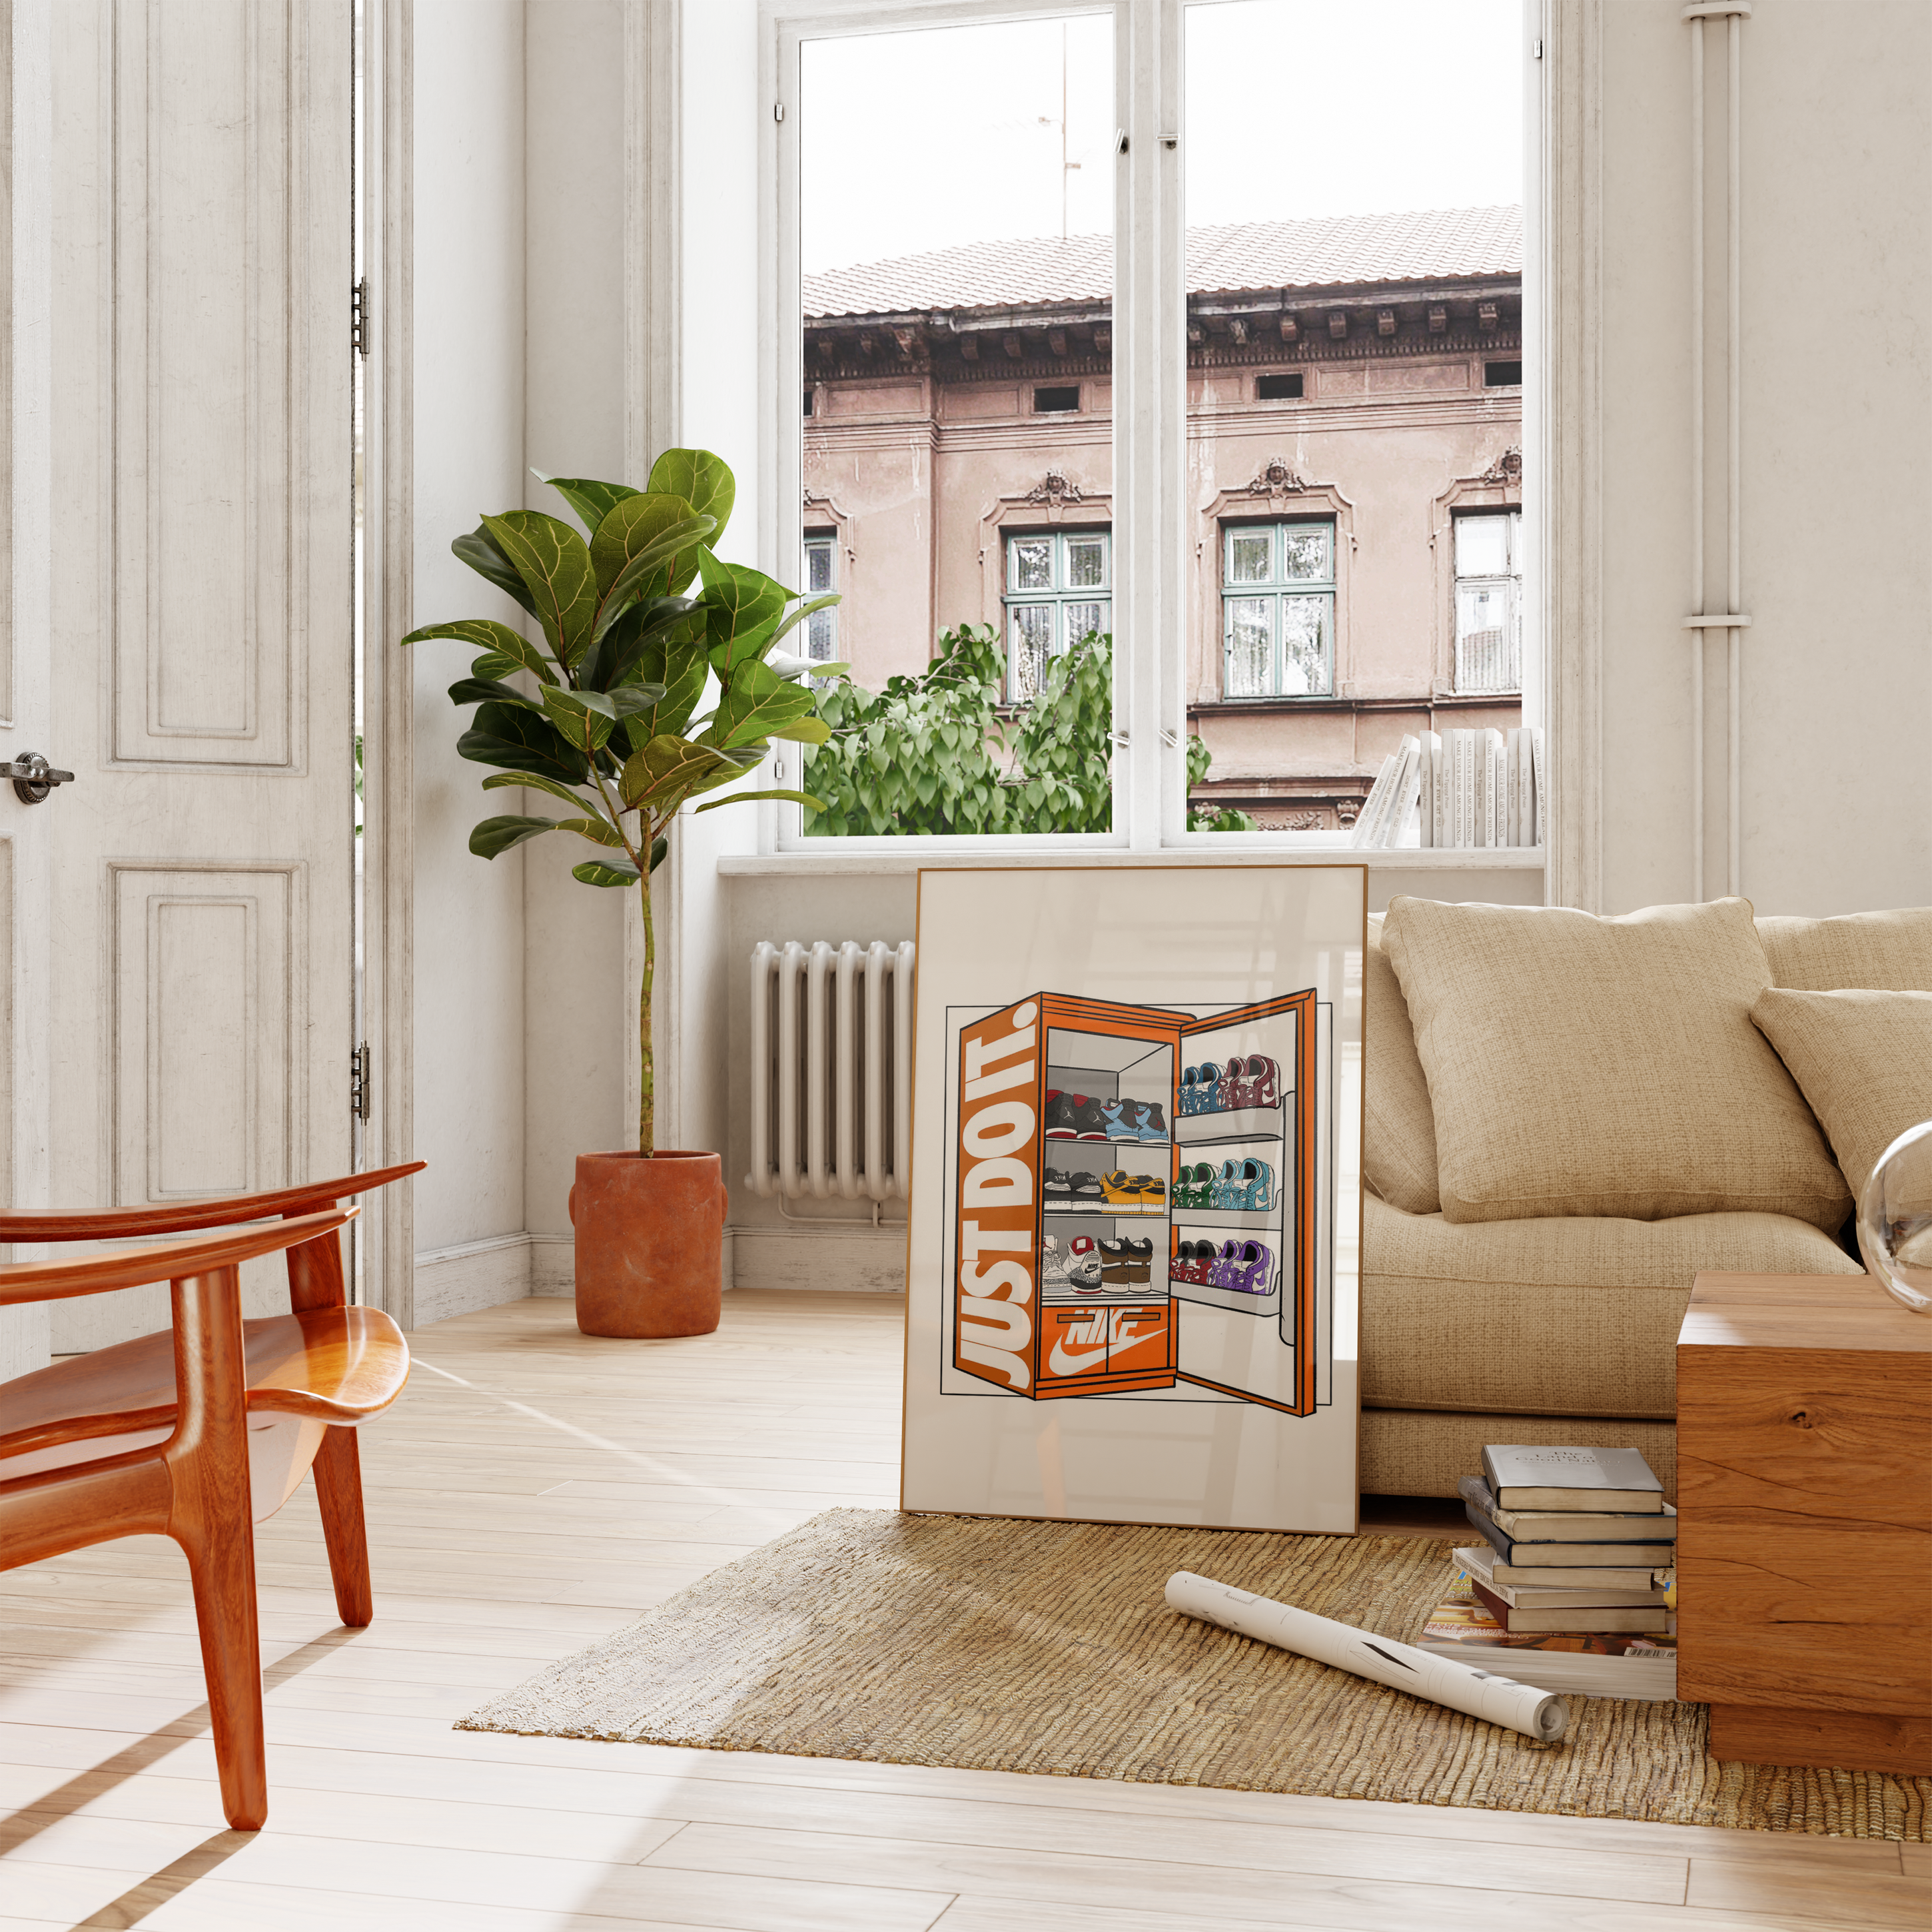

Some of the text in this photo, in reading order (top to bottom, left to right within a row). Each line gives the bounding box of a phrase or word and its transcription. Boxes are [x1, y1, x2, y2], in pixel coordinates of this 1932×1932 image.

[1392, 760, 1401, 778] YOUR
[1386, 777, 1396, 795] HOME
[1378, 793, 1388, 818] AMONG
[1369, 818, 1381, 841] FRIENDS
[962, 1101, 1036, 1208] DO
[960, 1220, 1033, 1390] JUST
[1065, 1308, 1143, 1345] NIKE
[1455, 1555, 1469, 1571] FRIENDS
[1499, 1586, 1508, 1599] MAKE
